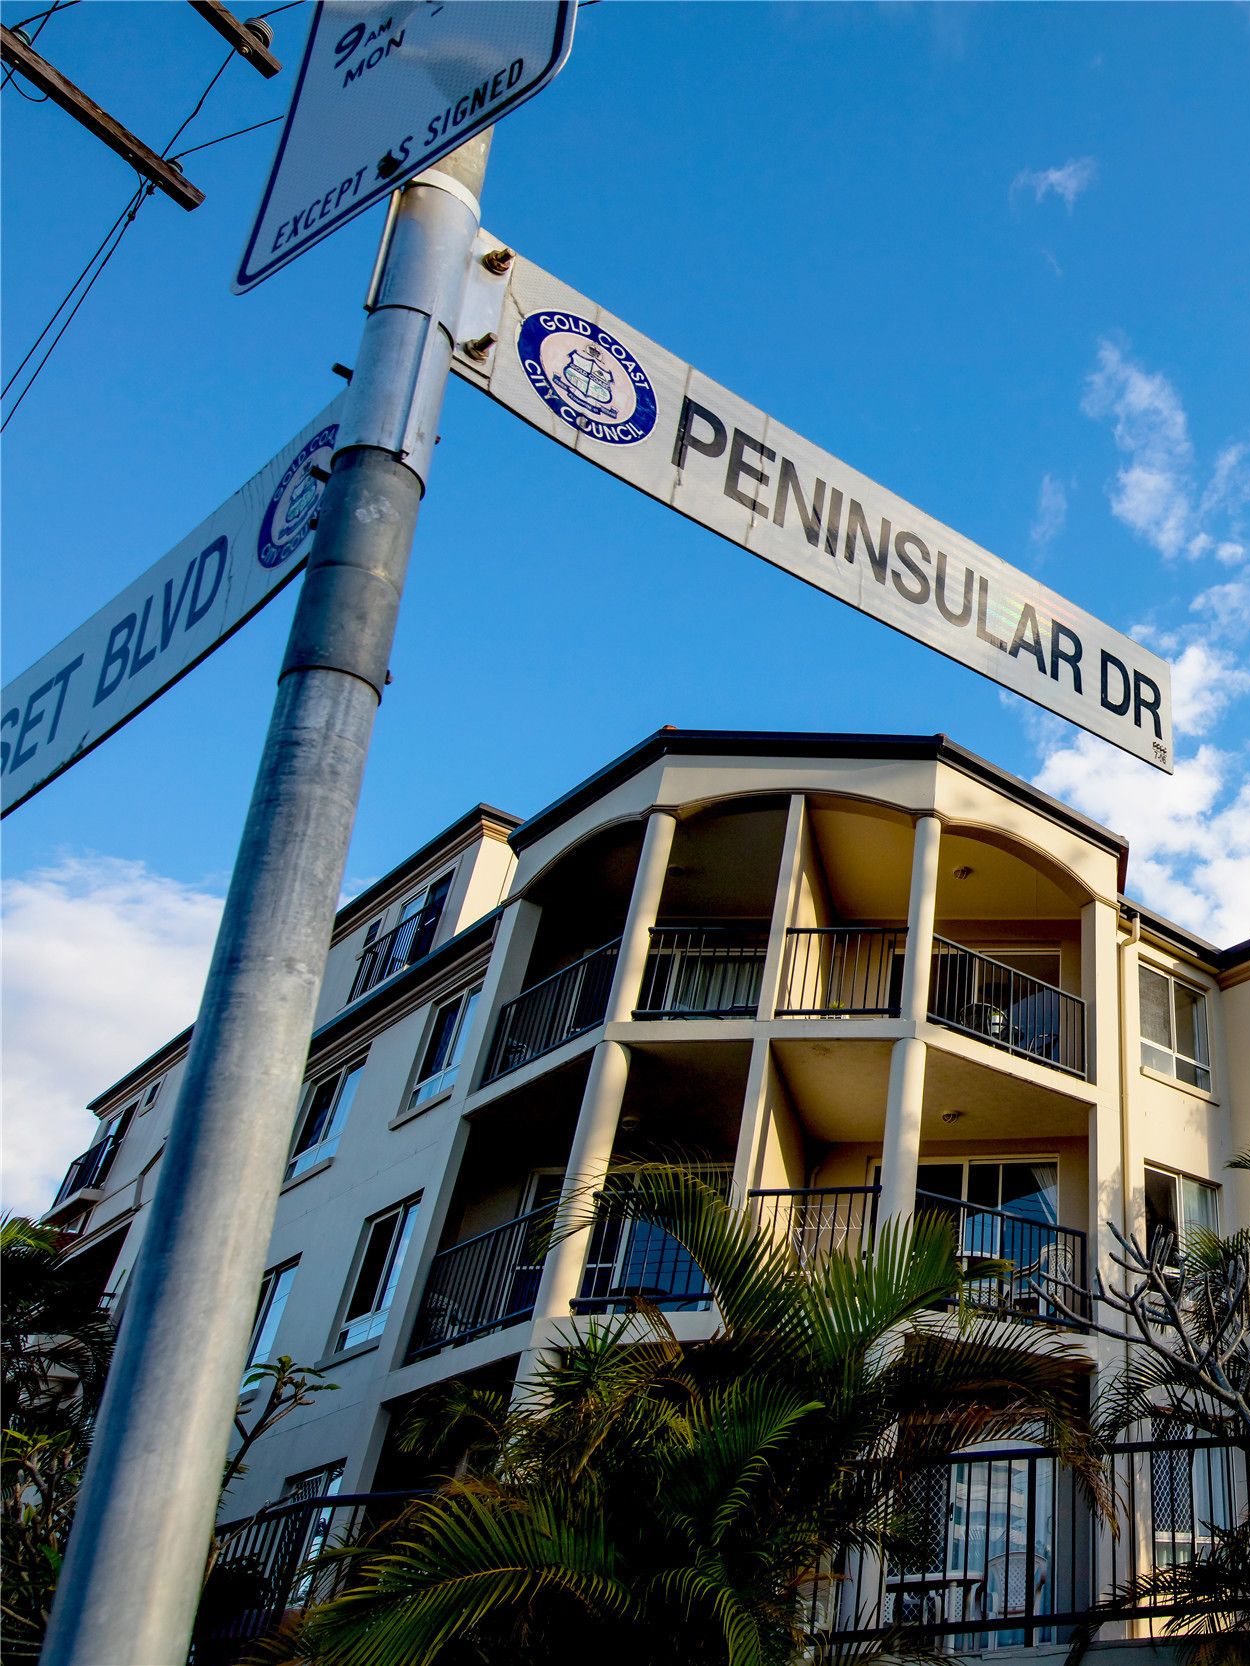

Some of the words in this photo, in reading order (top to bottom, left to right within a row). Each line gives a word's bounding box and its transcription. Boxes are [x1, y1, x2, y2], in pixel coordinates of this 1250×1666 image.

[343, 29, 405, 88] MON
[271, 166, 368, 253] EXCEPT
[424, 58, 524, 146] SIGNED
[539, 314, 591, 336] GOLD
[597, 332, 651, 390] COAST
[310, 428, 336, 451] COA
[524, 358, 560, 400] CITY
[560, 405, 646, 442] COUNCIL
[671, 395, 1084, 696] PENINSULAR
[1099, 648, 1164, 739] DR
[0, 653, 84, 776] SET
[92, 534, 228, 708] BLVD
